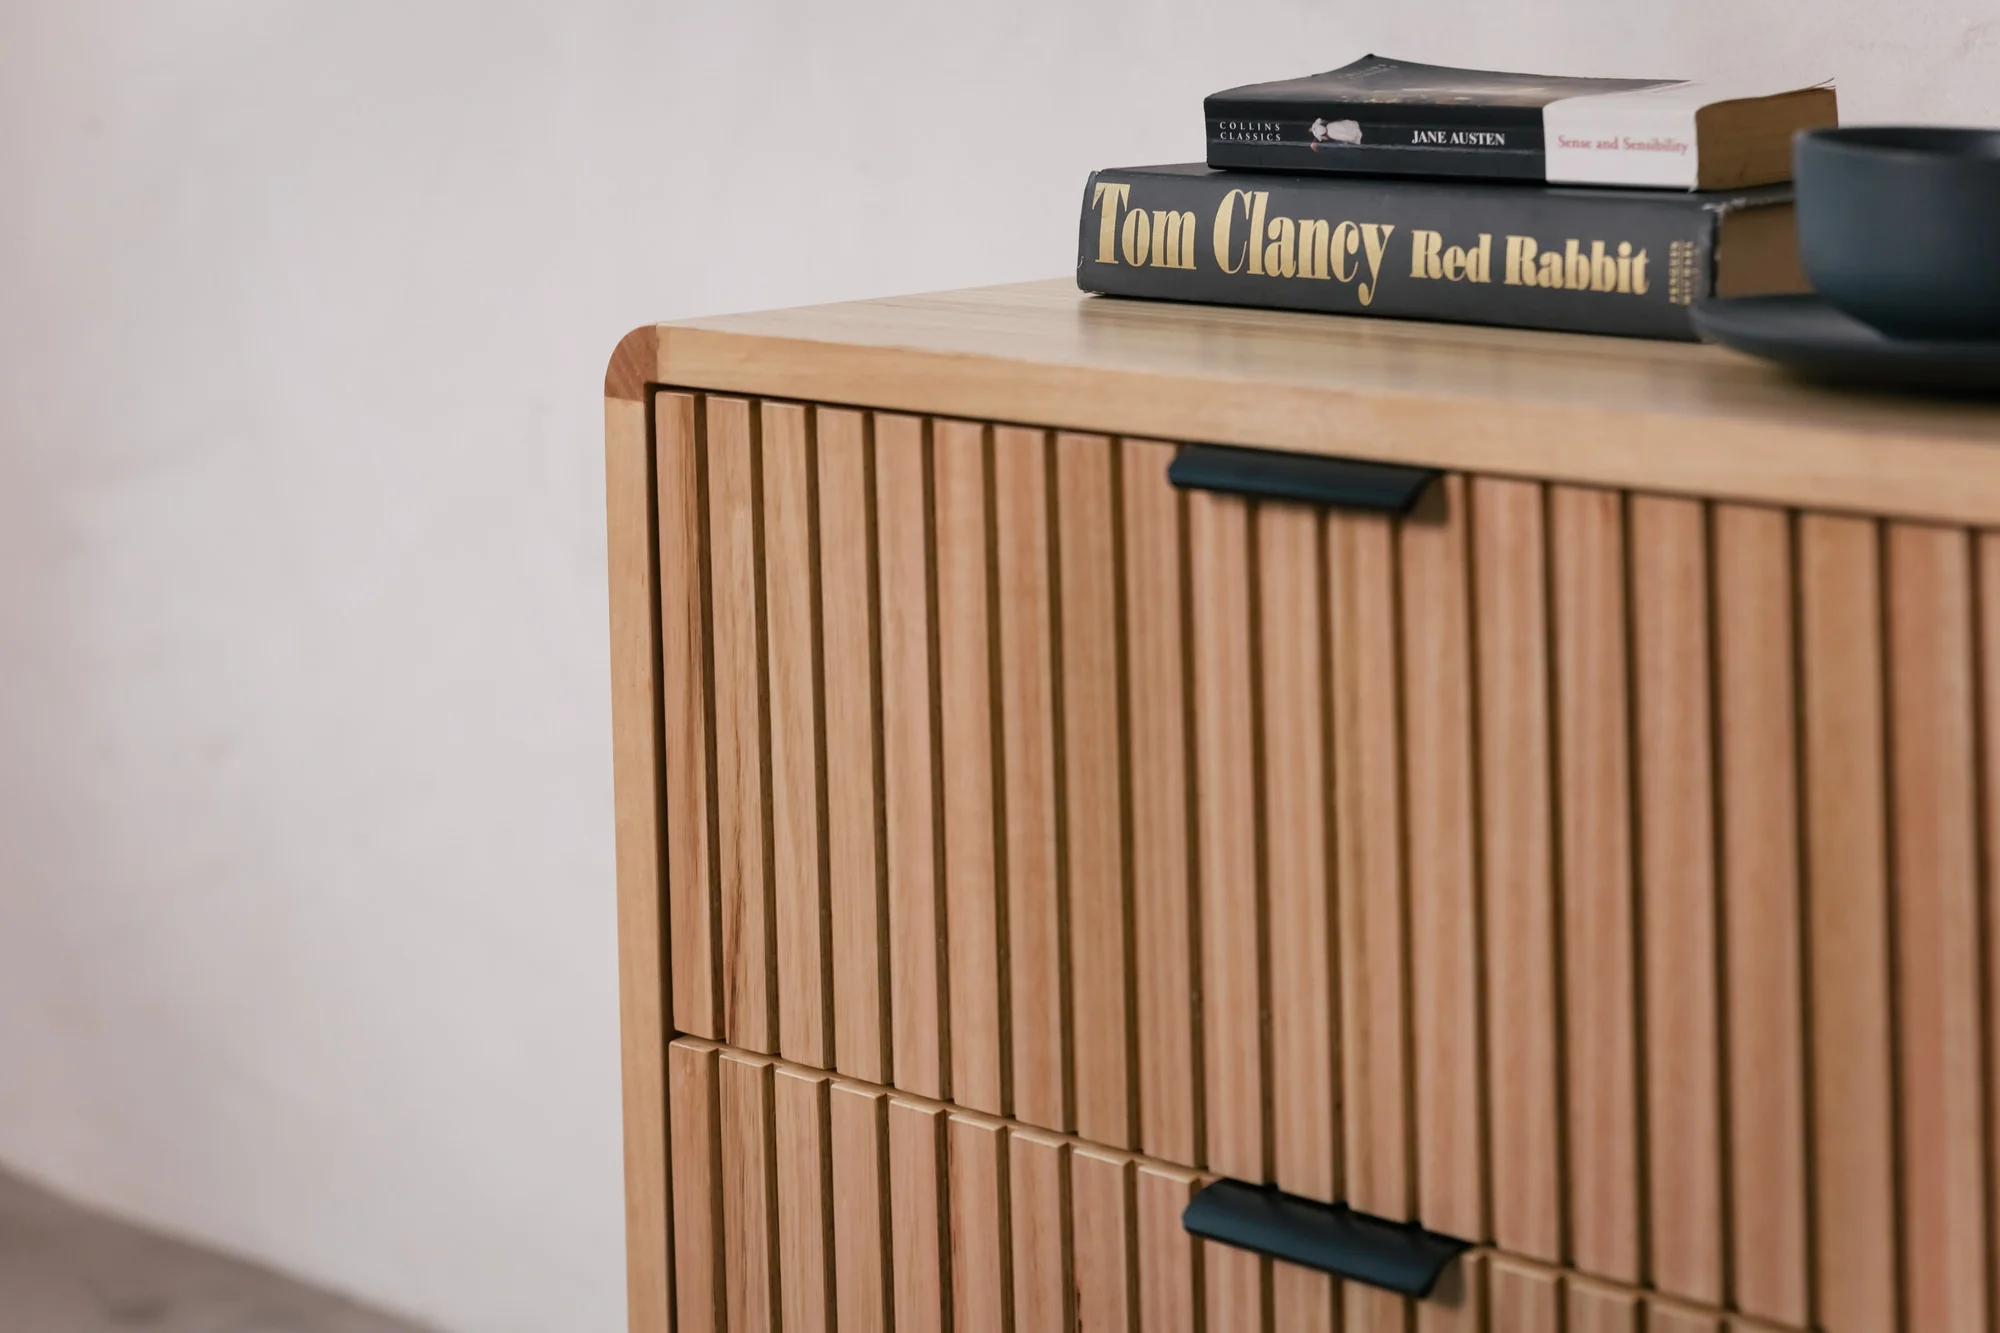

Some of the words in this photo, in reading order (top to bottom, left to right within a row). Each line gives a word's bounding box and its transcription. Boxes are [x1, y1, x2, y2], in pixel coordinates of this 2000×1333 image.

[1219, 121, 1280, 131] COLLINS
[1220, 131, 1281, 142] CLASSICS
[1411, 130, 1447, 144] JANE
[1449, 131, 1505, 146] AUSTEN
[1557, 134, 1592, 149] Sense
[1595, 135, 1619, 150] and
[1622, 136, 1689, 157] Sensibility
[1092, 181, 1197, 270] Tom
[1212, 188, 1395, 306] Clancy
[1409, 229, 1492, 283] Red
[1504, 234, 1650, 295] Rabbit
